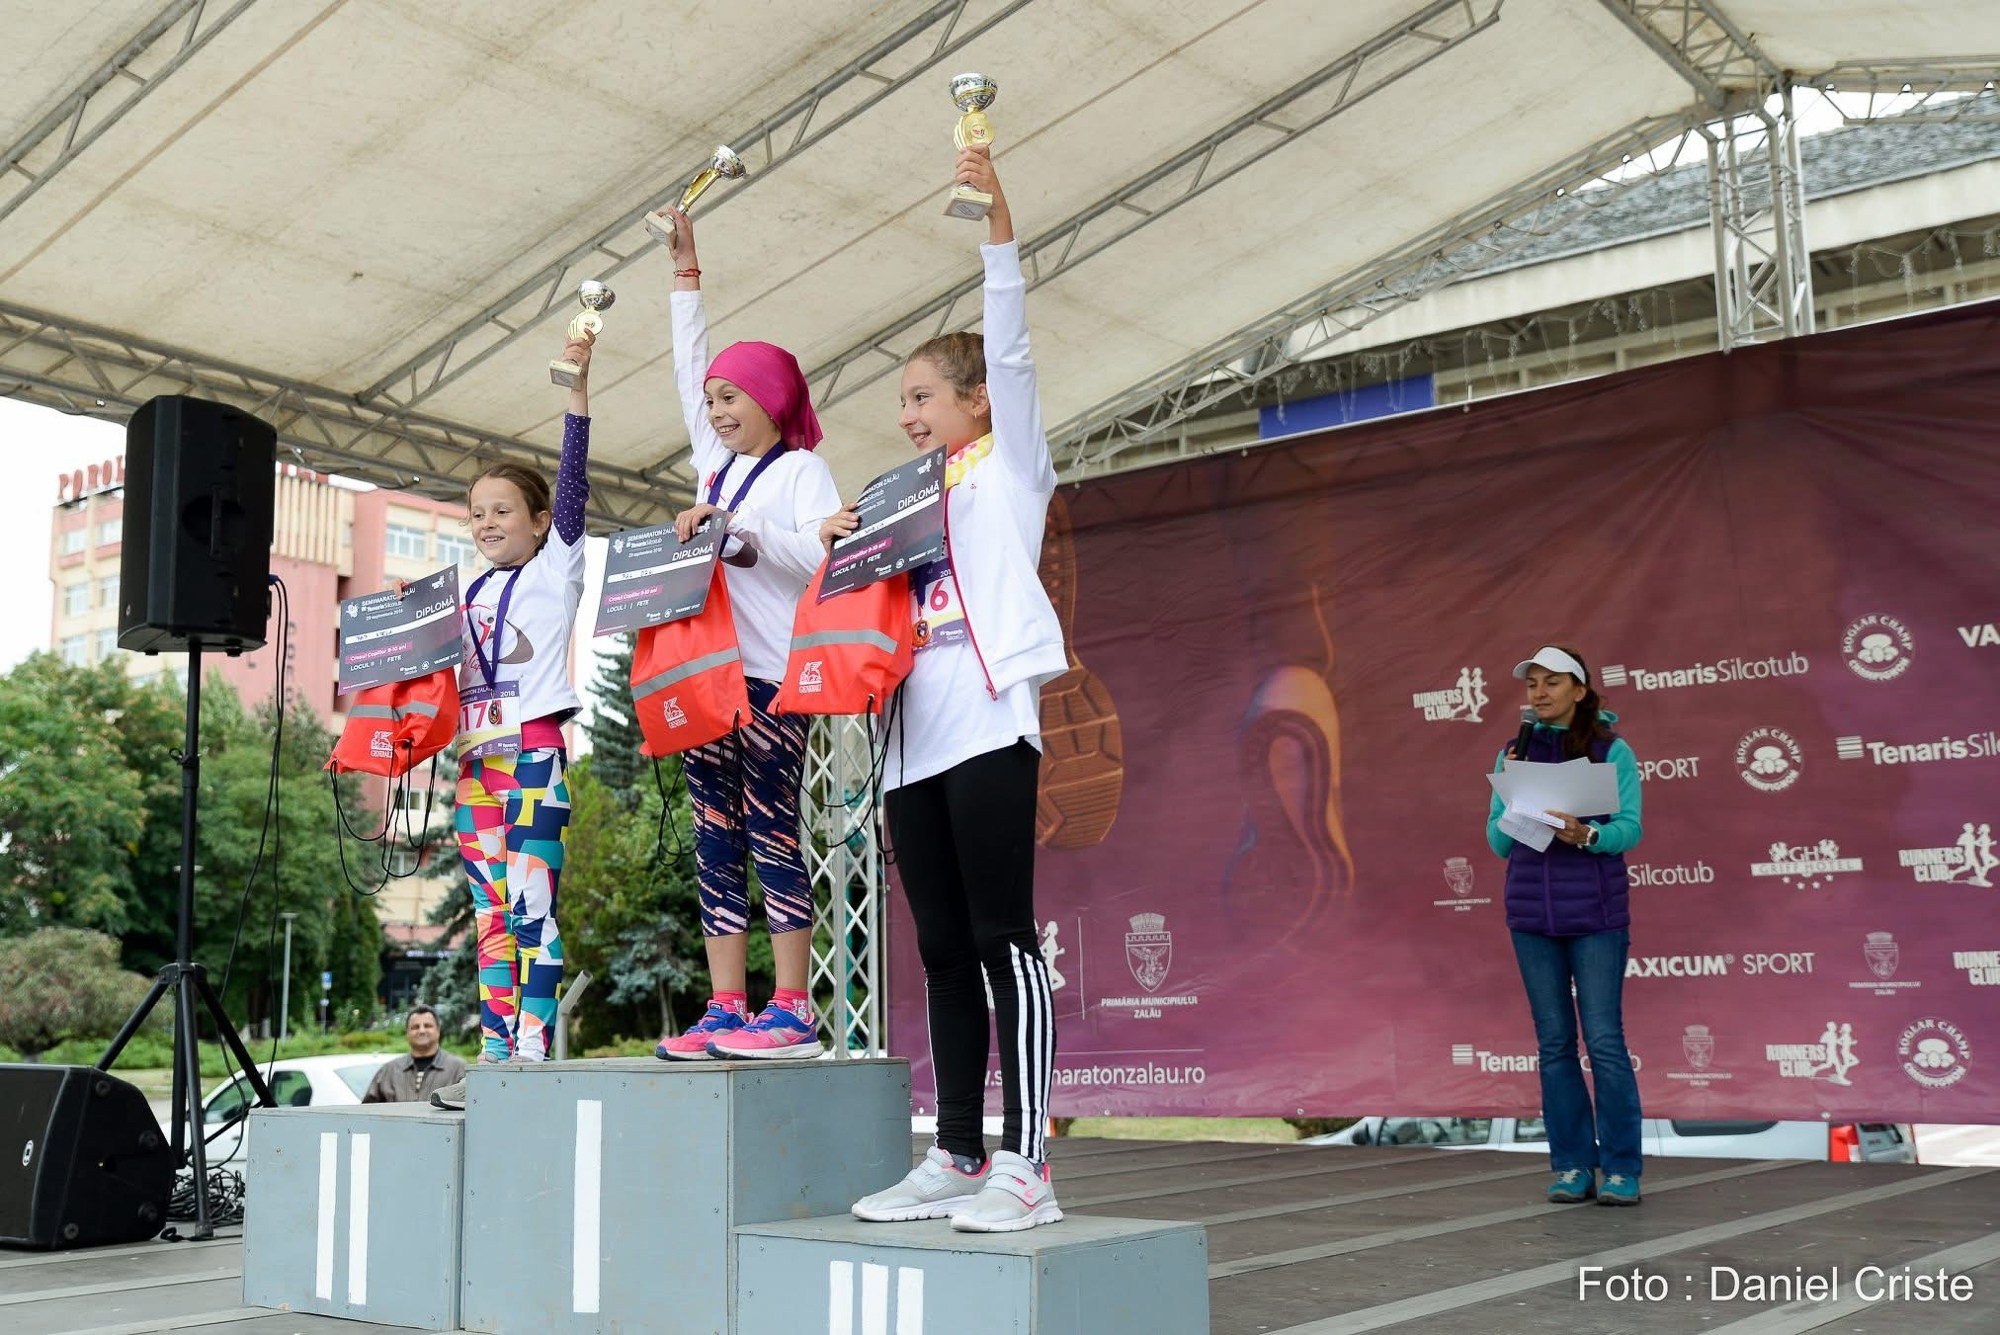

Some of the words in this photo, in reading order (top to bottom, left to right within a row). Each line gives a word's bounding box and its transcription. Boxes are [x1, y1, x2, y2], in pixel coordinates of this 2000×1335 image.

[897, 479, 940, 510] DIPLOMĂ
[671, 543, 714, 562] DIPLOMĂ
[940, 568, 952, 578] 201
[415, 594, 455, 619] DIPLOMĂ
[1843, 615, 1877, 653] BOGLAR
[1880, 616, 1913, 651] CHAMP
[1957, 624, 2000, 648] VA
[1628, 650, 1809, 691] TenarisSilcotub
[500, 690, 516, 698] 2018
[1412, 688, 1462, 708] RUNNERS
[1424, 705, 1454, 721] CLUB
[1736, 727, 1769, 764] BOGLAR
[1770, 728, 1801, 763] CHAMP
[1899, 847, 1965, 867] RUNNERS
[1914, 864, 1951, 883] CLUB
[1742, 952, 1815, 975] SPORT
[1133, 1009, 1161, 1018] ZALĂU
[1899, 1019, 1935, 1055] BOGLAR
[1937, 1021, 1970, 1060] CHAMP
[1766, 1044, 1826, 1061] RUNNERS
[1780, 1058, 1813, 1077] CLUB
